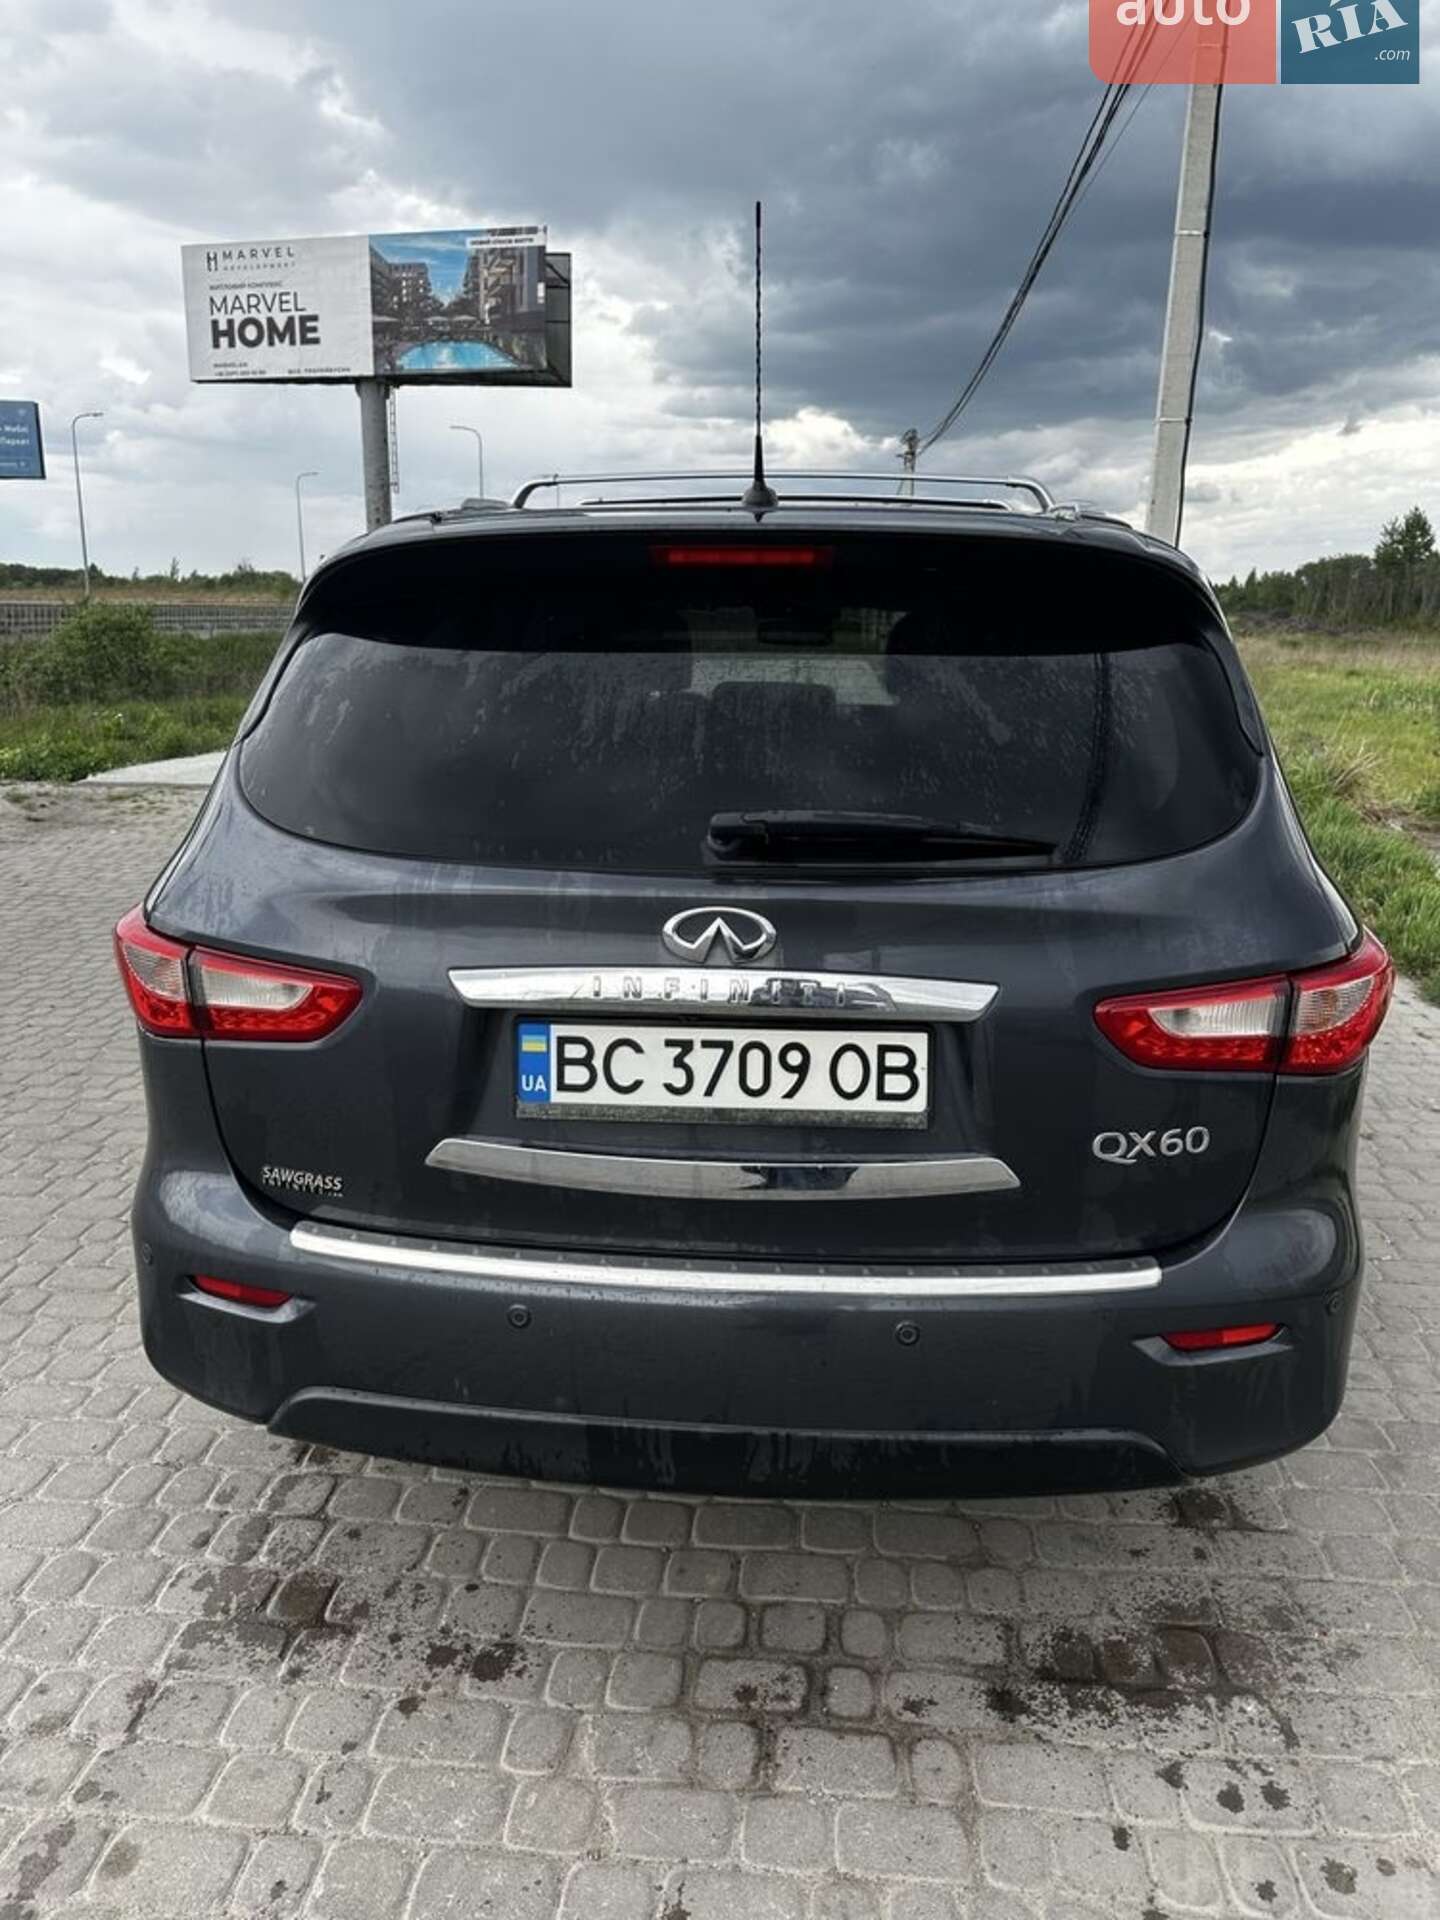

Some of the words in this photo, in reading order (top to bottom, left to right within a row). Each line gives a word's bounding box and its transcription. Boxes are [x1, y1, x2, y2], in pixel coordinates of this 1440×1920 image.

[222, 246, 295, 260] MARVEL
[209, 291, 306, 316] MARVEL
[211, 314, 321, 349] HOME
[592, 975, 846, 1007] INFINITI
[555, 1036, 645, 1094] BC
[662, 1039, 811, 1099] 3709
[829, 1043, 921, 1101] OB
[521, 1074, 547, 1093] UA
[1092, 1126, 1211, 1165] QX60
[262, 1165, 343, 1191] SAWGRASS
